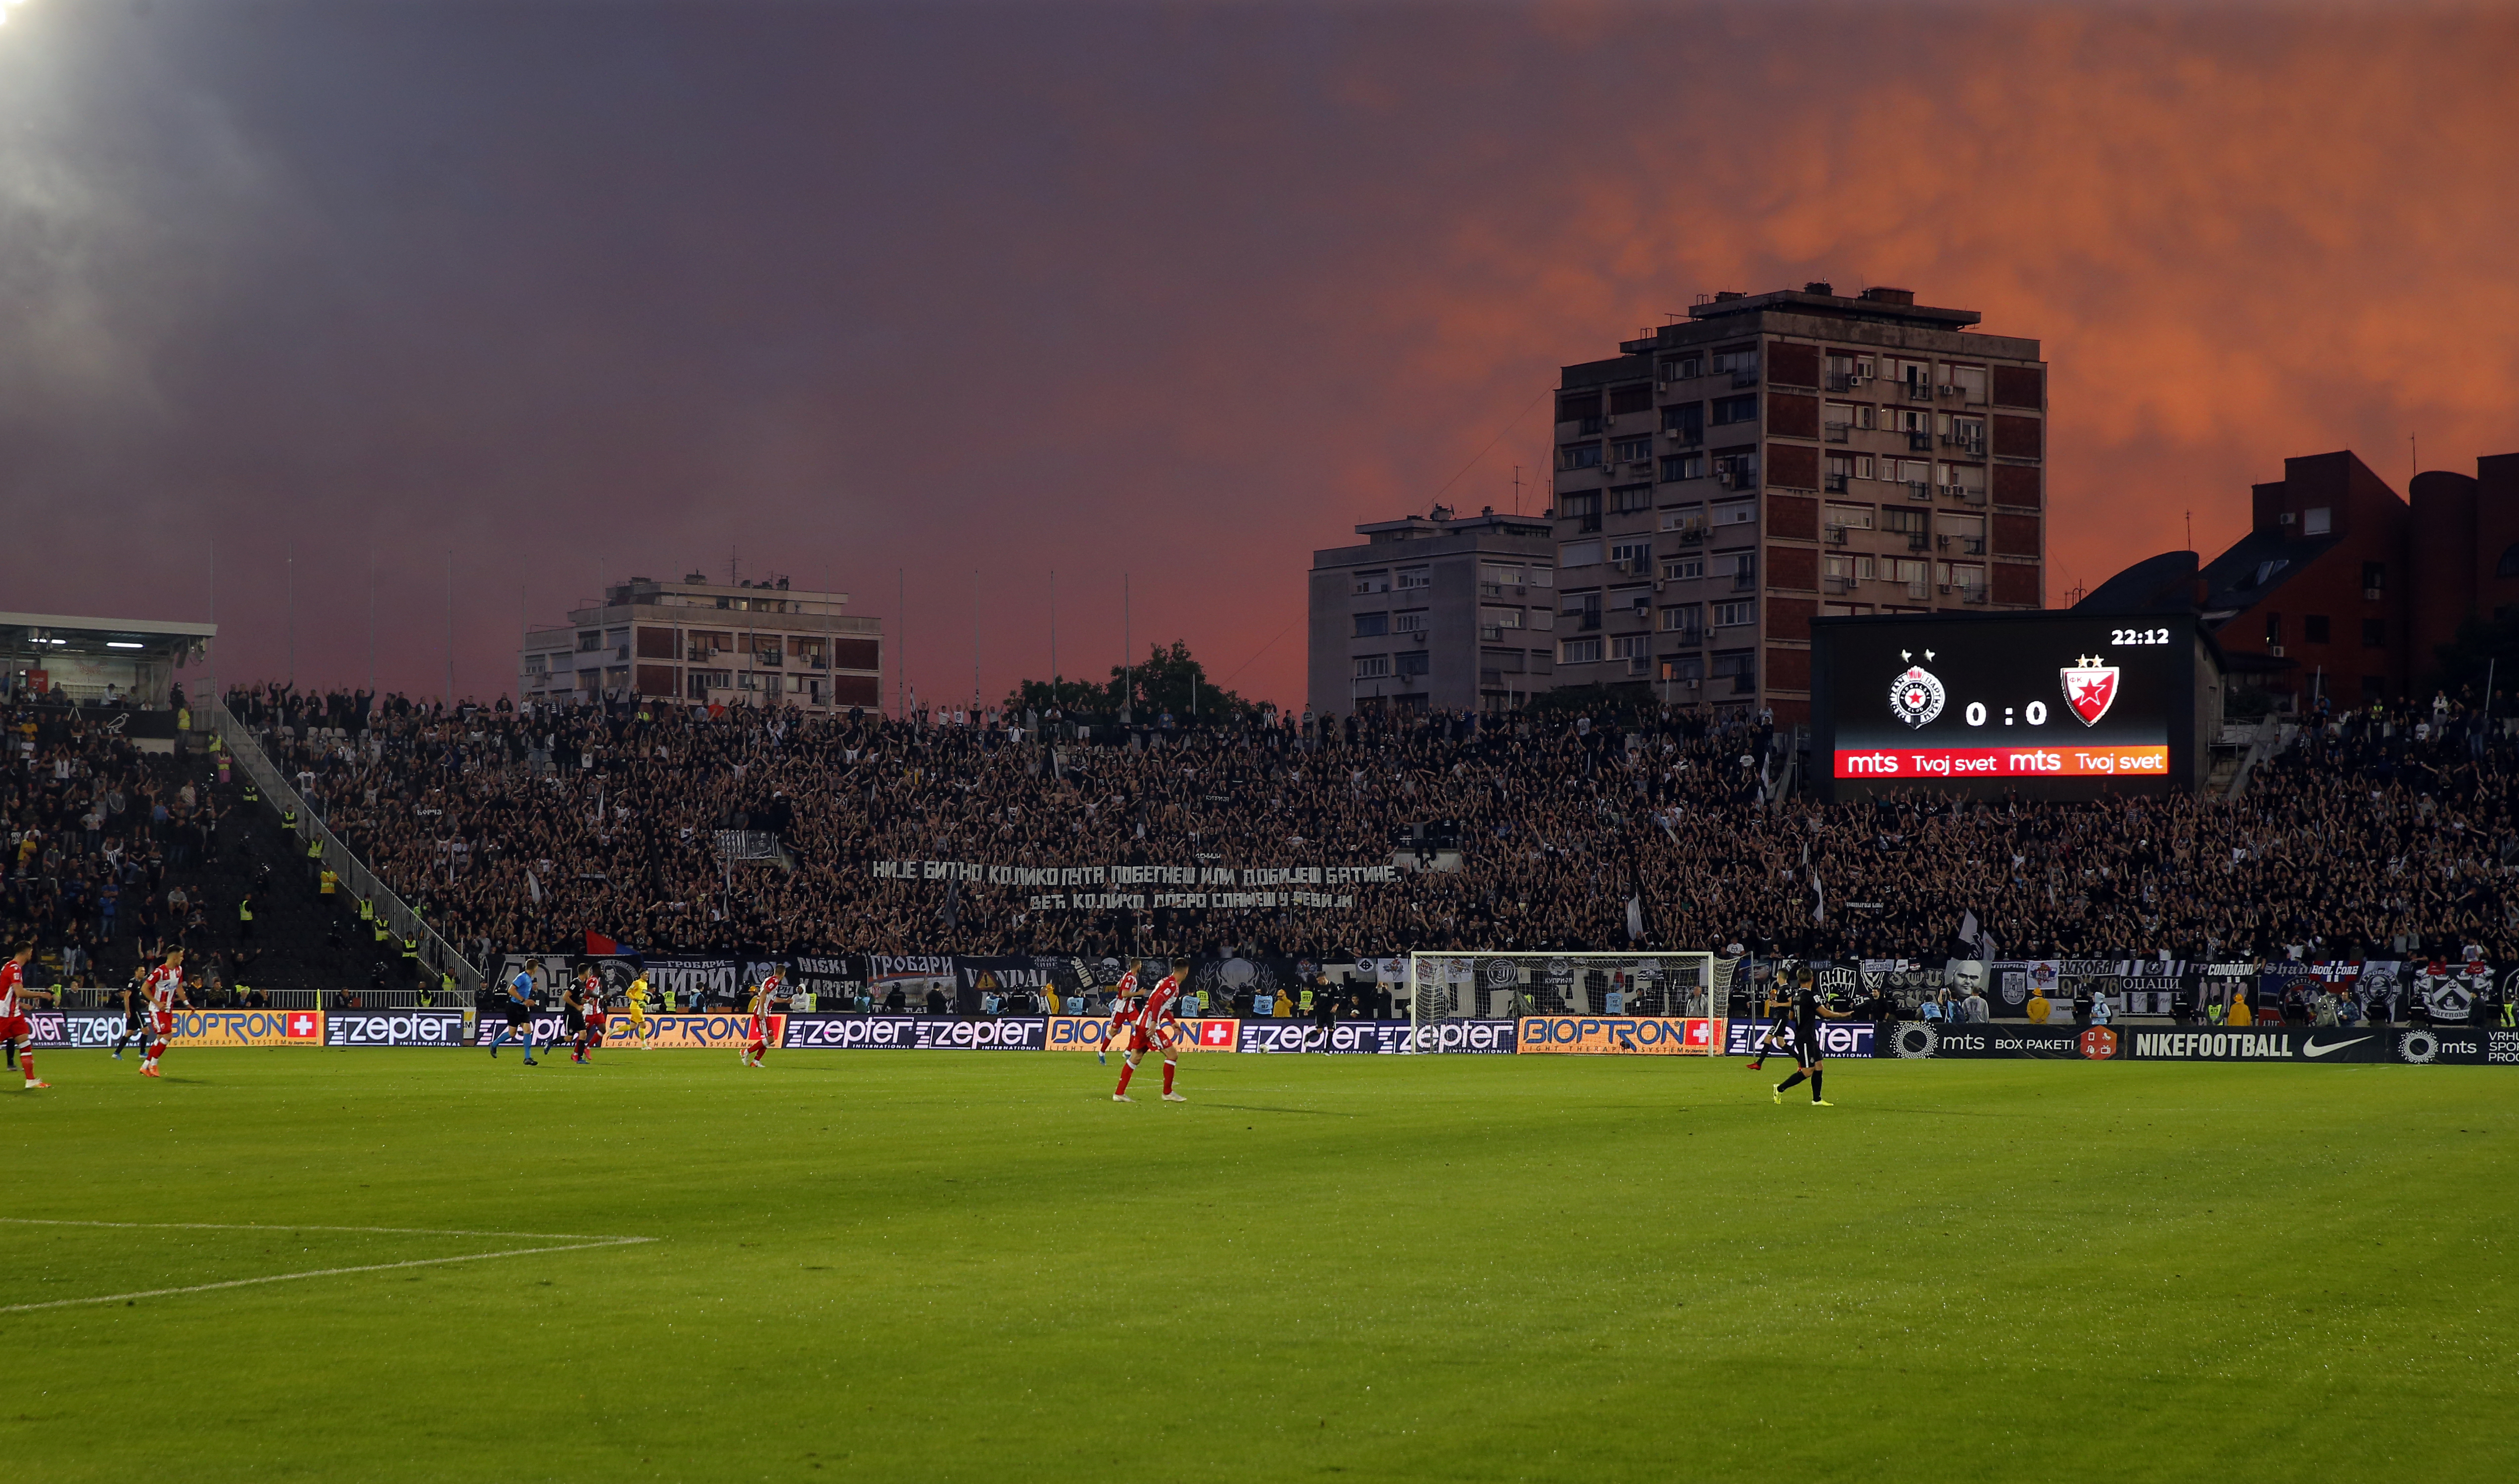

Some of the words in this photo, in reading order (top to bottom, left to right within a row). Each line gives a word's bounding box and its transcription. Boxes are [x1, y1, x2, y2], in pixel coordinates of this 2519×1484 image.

[2111, 628, 2170, 646] 22:12
[1965, 701, 1987, 726] 0
[2025, 700, 2048, 726] 0
[1848, 752, 1899, 773] mts
[1912, 755, 1950, 776] Tvoj
[1955, 755, 1997, 771] svet
[2009, 750, 2061, 771] mts
[2075, 753, 2114, 774] Tvoj
[2119, 753, 2163, 770] svet
[873, 861, 917, 879] НИЈЕ
[924, 861, 983, 881] БИТНО
[989, 866, 1058, 885] КОЛИКО
[1062, 867, 1104, 885] ПУТА
[1111, 866, 1196, 884] ПОБЕГНЕШ
[1201, 867, 1235, 885] ИЛИ
[1243, 867, 1321, 886] ДОБИЈЕШ
[1030, 894, 1066, 910] ВЕЋ
[1073, 893, 1145, 909] КОЛИКО
[1153, 892, 1207, 908] ДОБРО
[666, 960, 726, 968] ГРОБАРИ
[870, 955, 954, 979] ГРОБАРИ
[2335, 965, 2359, 975] CORE
[2287, 978, 2321, 988] PARTIZAN
[344, 1012, 462, 1046] zepter
[804, 1017, 914, 1048] zepter
[932, 1018, 1044, 1050] zepter
[1523, 1019, 1685, 1052] BIOPTRON
[1943, 1034, 1985, 1050] mts
[1995, 1039, 2022, 1050] BOX
[2026, 1039, 2075, 1050] PAKETI
[2136, 1033, 2293, 1057] NIKEFOOTBALL
[2442, 1040, 2477, 1054] mts
